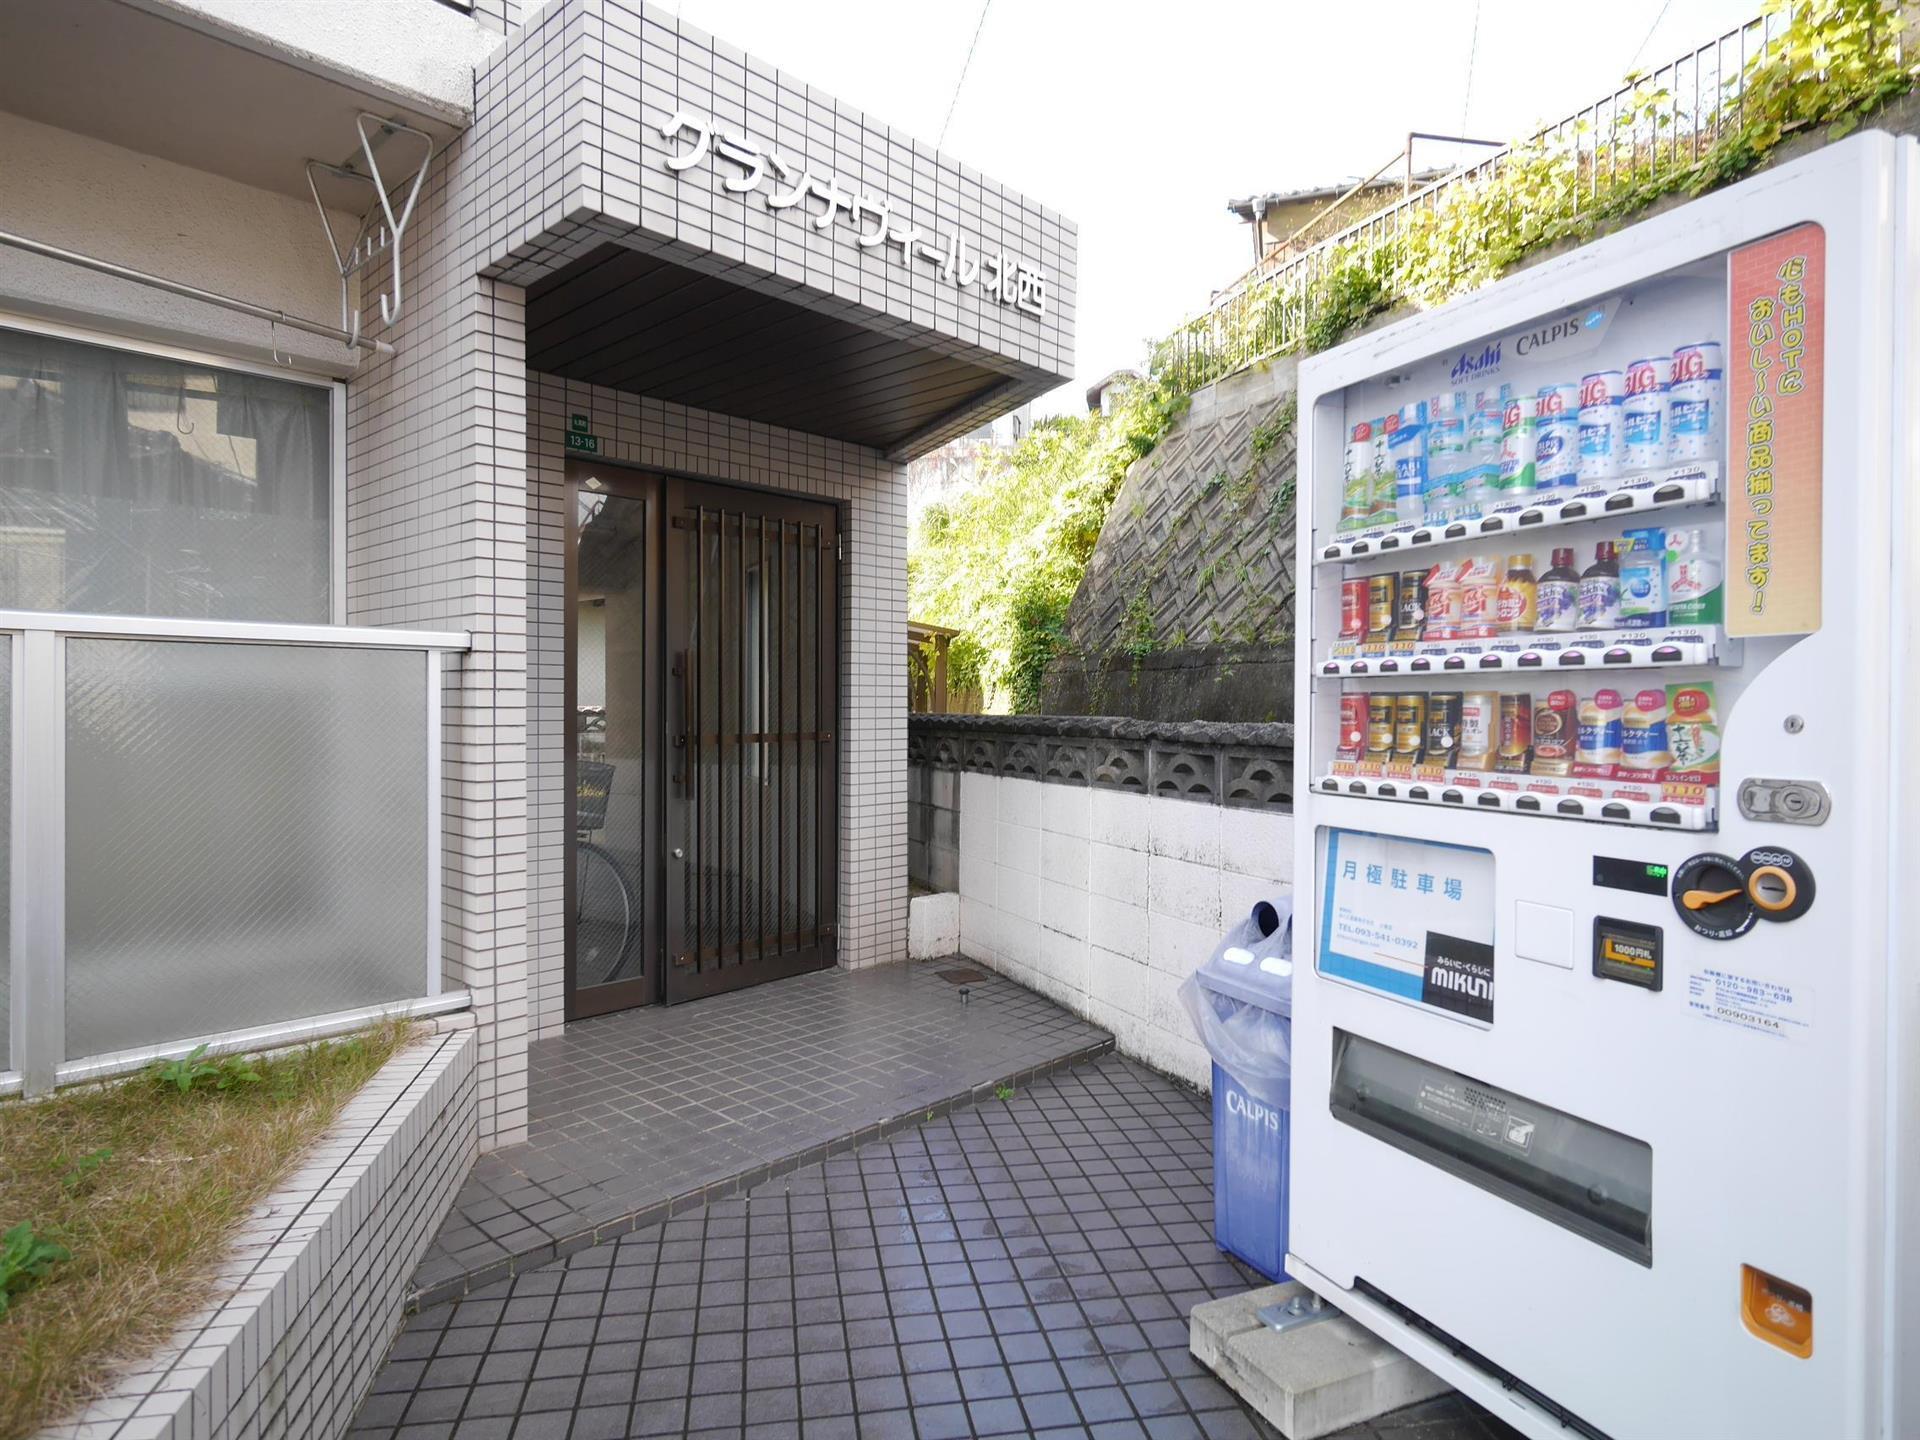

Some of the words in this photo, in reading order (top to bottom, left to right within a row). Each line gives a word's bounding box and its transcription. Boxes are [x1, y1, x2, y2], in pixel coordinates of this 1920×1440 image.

[1516, 318, 1579, 356] CALPIS
[1778, 257, 1806, 394] 心もHOTに
[1451, 341, 1501, 378] Asahi
[570, 435, 595, 449] 13-16
[1343, 861, 1463, 901] 月極駐車場
[1226, 1090, 1279, 1131] CALPIS
